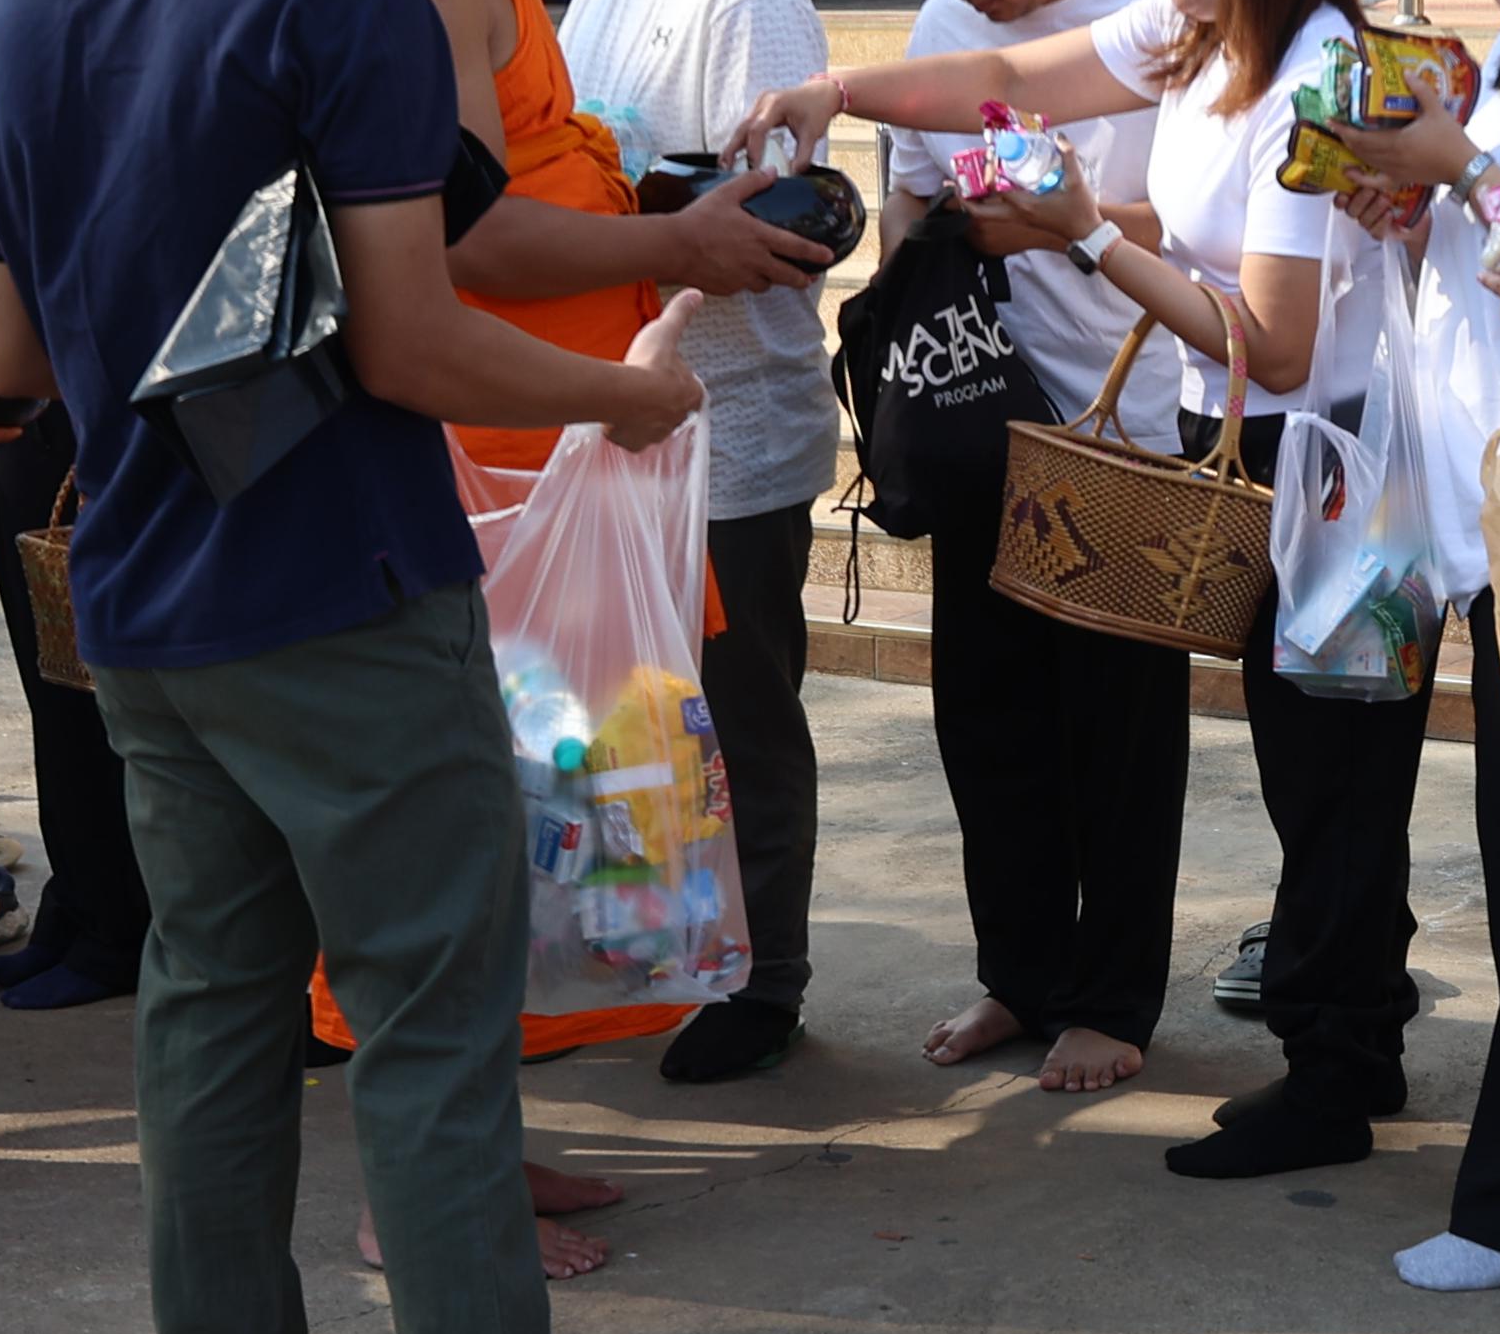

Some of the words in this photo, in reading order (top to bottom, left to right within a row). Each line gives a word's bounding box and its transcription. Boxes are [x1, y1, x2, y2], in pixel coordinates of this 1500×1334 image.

[881, 293, 986, 383] MATH
[900, 319, 1015, 398] SCIENC
[932, 374, 1008, 408] PROGRAM
